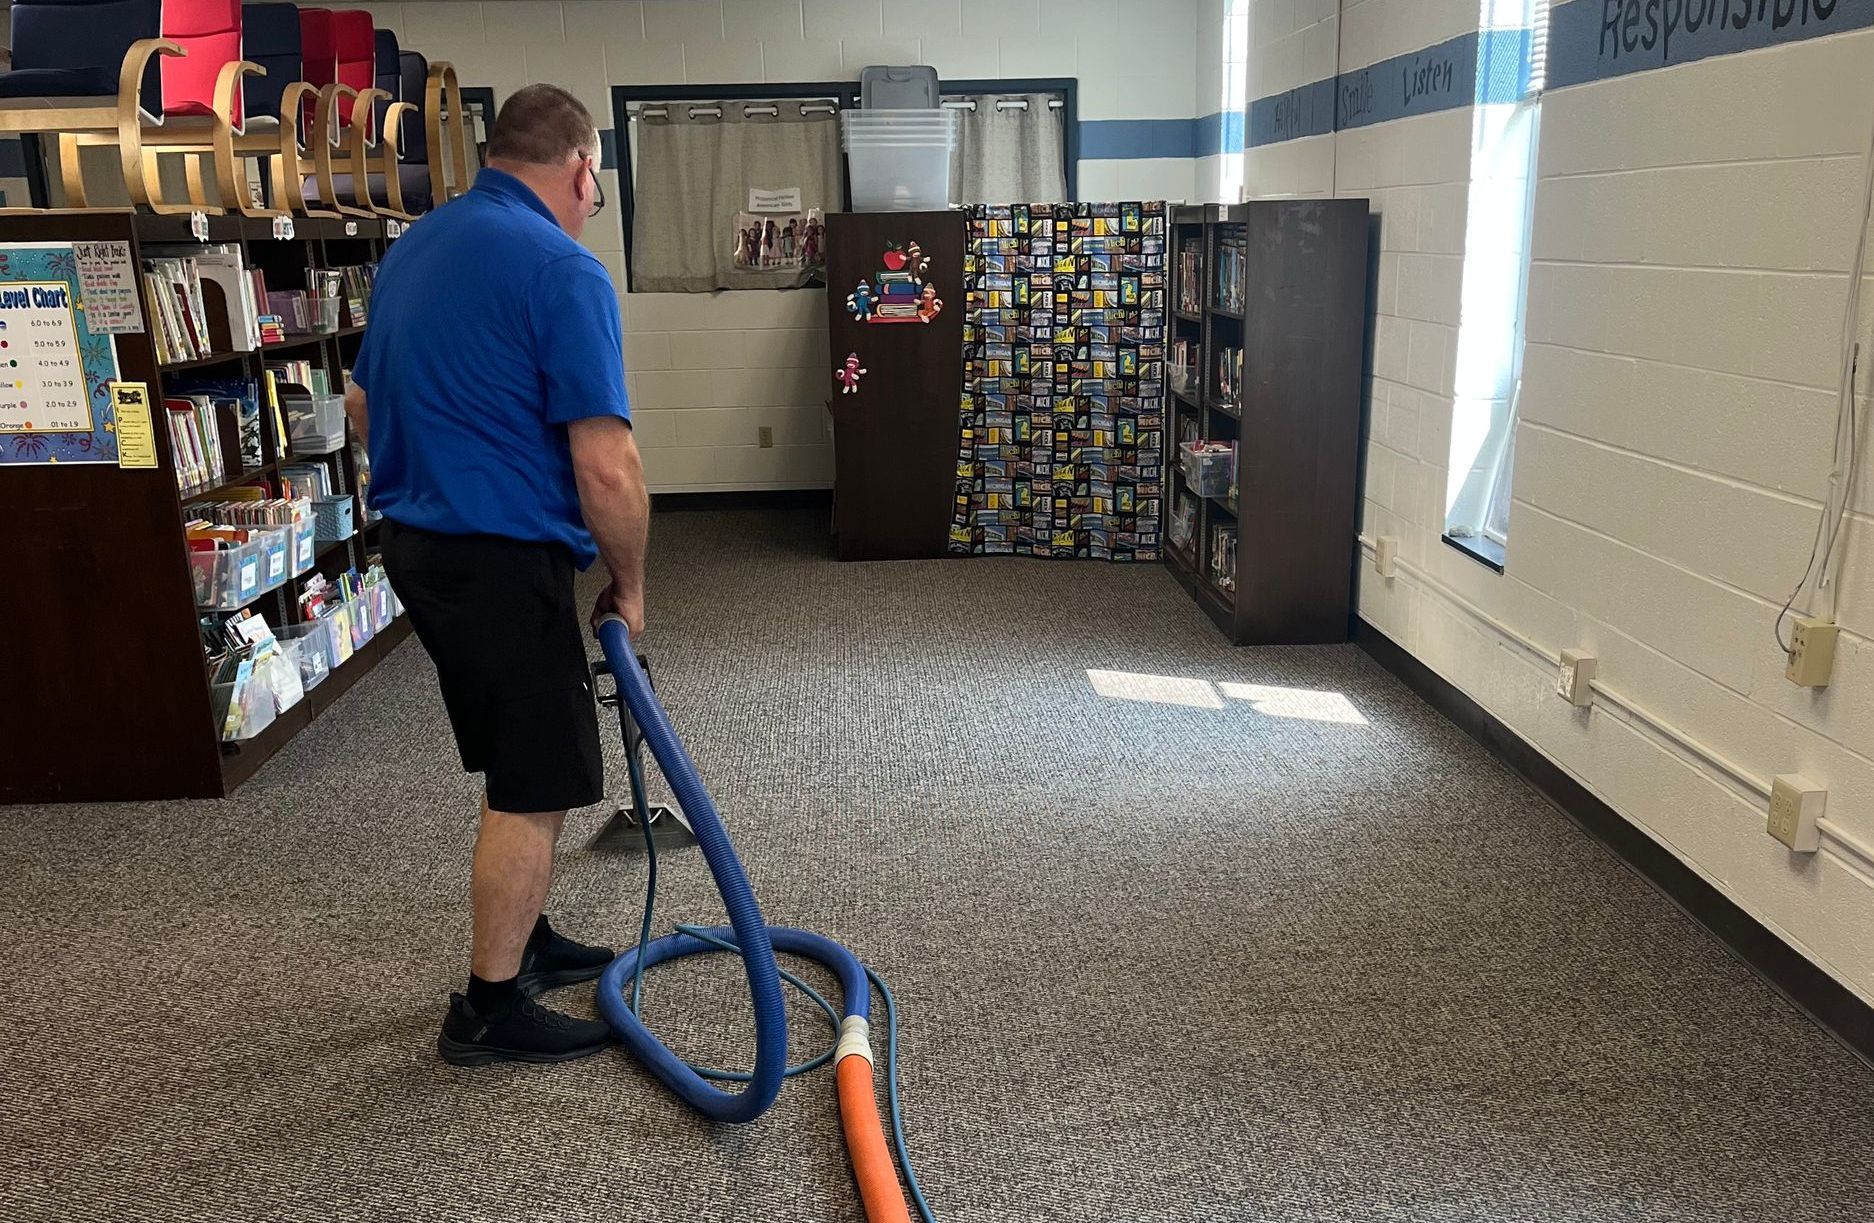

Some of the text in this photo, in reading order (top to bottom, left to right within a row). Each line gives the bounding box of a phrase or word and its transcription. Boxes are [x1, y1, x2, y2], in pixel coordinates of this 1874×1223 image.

[1342, 71, 1374, 126] Smile
[1402, 56, 1453, 107] Listen
[0, 286, 68, 309] Level Chart
[0, 422, 24, 431] Orange
